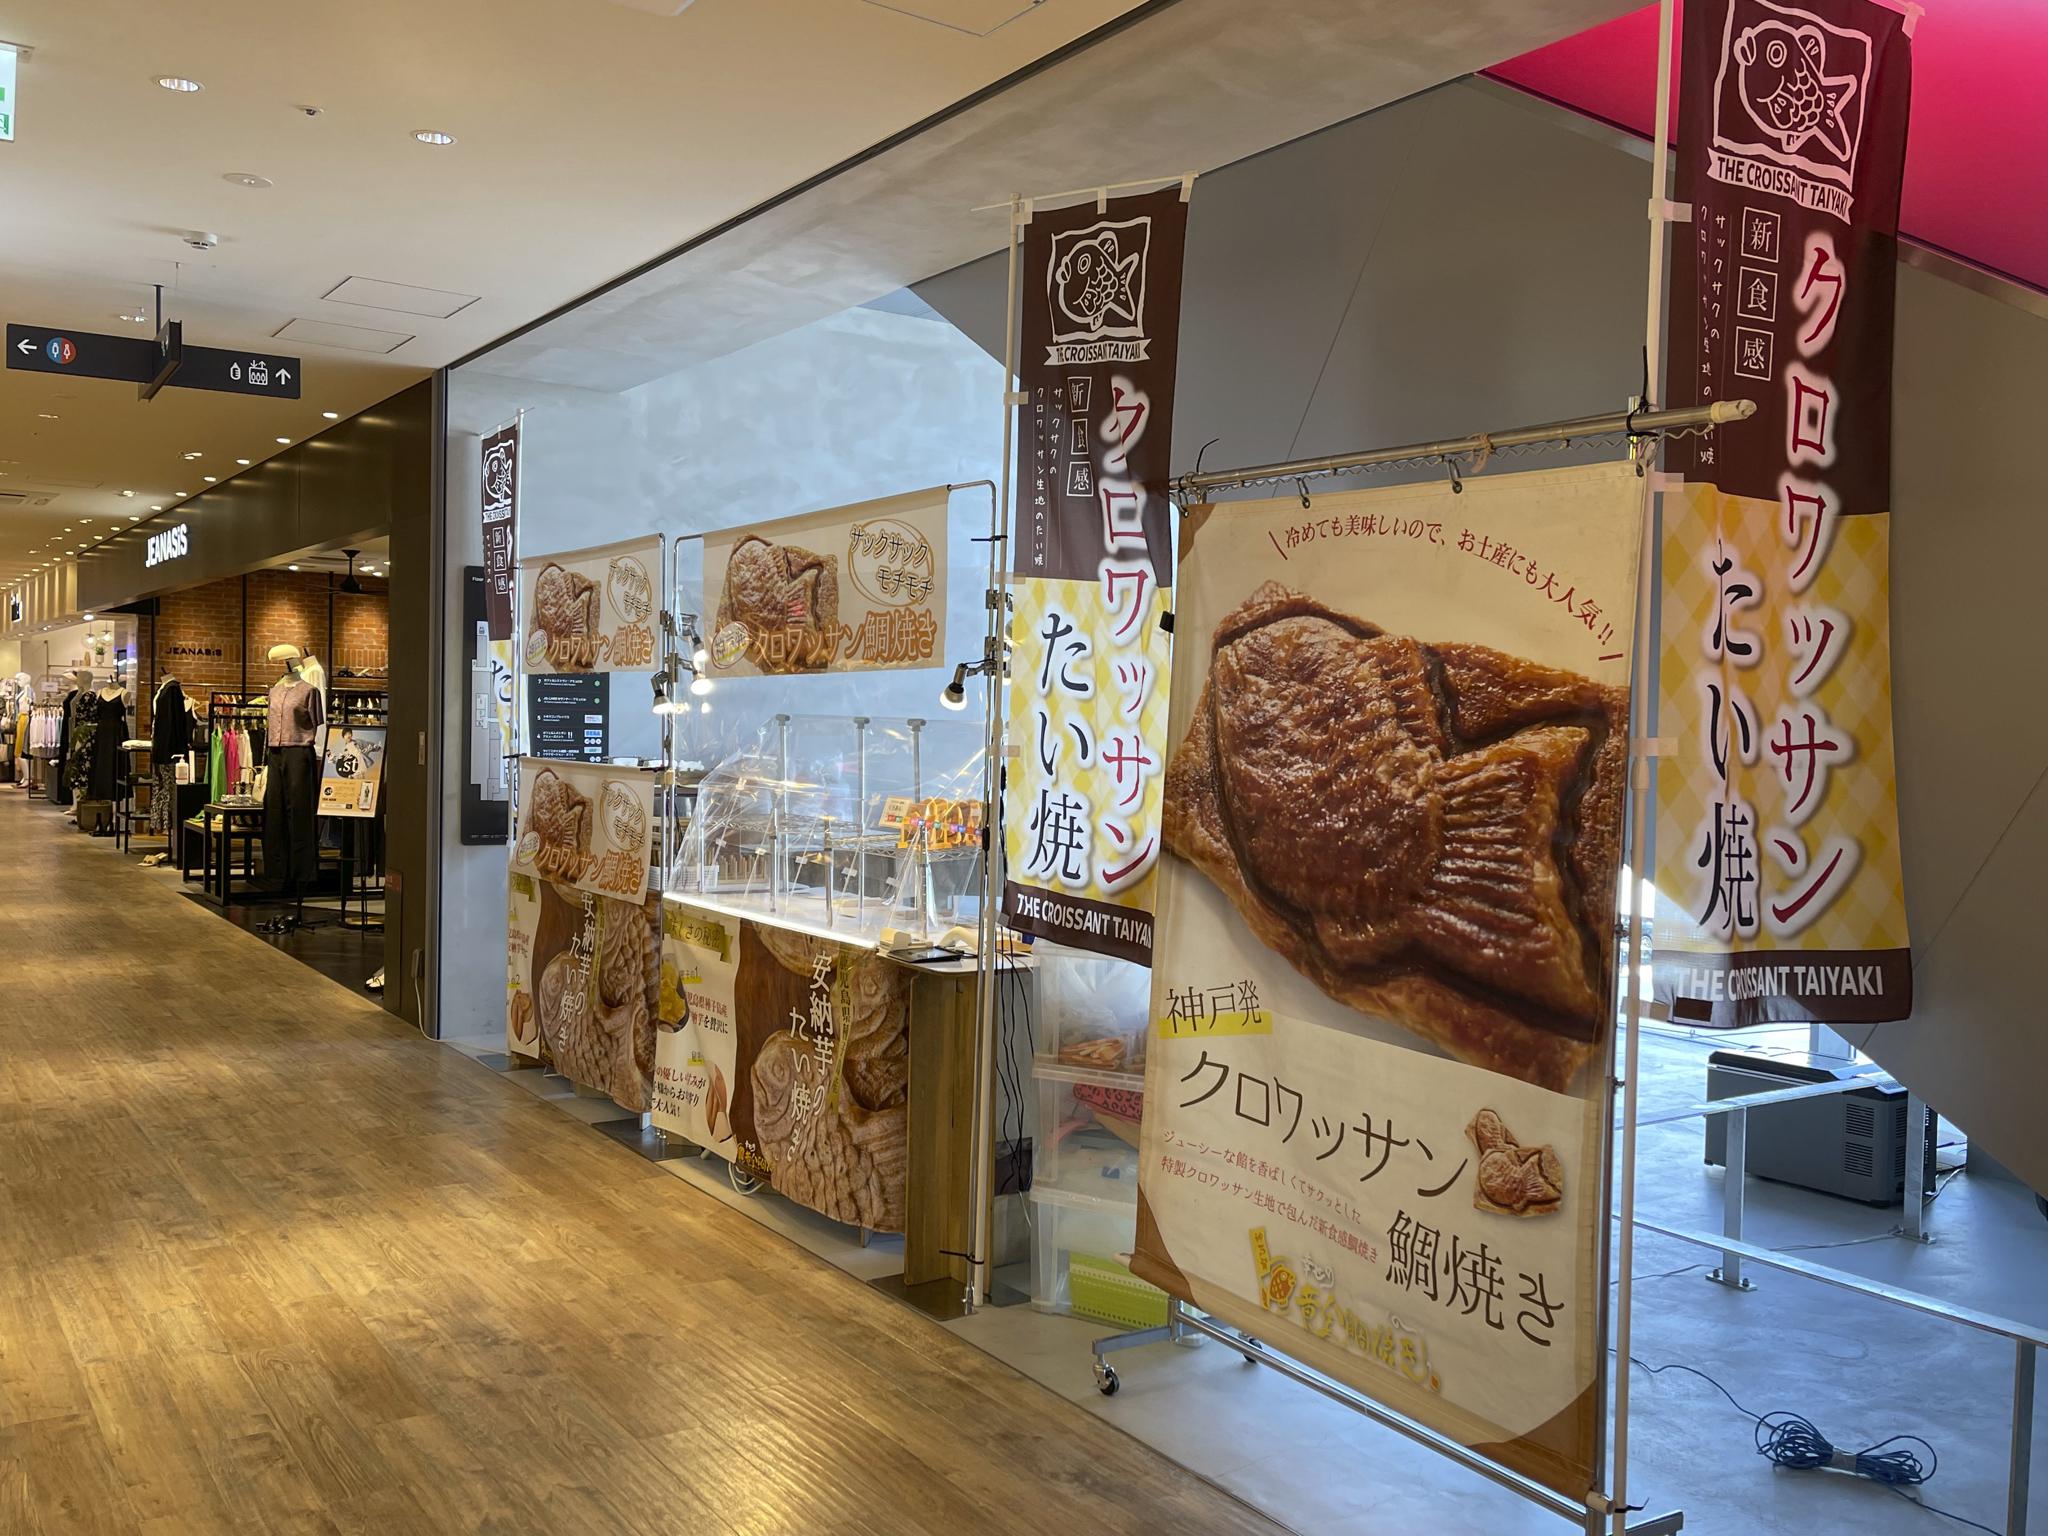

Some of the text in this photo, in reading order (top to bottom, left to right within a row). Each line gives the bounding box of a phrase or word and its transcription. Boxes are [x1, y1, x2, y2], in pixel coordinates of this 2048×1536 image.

[1717, 156, 1744, 183] THE
[1711, 214, 1725, 339] サックサクの
[1743, 218, 1773, 370] 新食感
[1049, 387, 1063, 475] サックサクの
[851, 525, 929, 567] サックサック
[877, 566, 934, 602] モチモチ
[1770, 247, 1843, 924] クロワッサン
[754, 609, 937, 664] クロワッサン鯛焼き
[1102, 387, 1153, 884] クロワッサン
[1028, 612, 1089, 880] たい焼
[1698, 539, 1755, 930] たい焼
[1016, 893, 1041, 919] THE
[1042, 900, 1111, 935] CROISSANT
[810, 950, 834, 1117] 安納芋の
[1166, 980, 1262, 1034] 神戸発
[1677, 967, 1724, 1001] THE
[1794, 966, 1884, 996] TAIYAKI
[787, 1005, 812, 1162] たい焼き
[1180, 1051, 1468, 1197] クロワッサン
[1385, 1209, 1565, 1347] 鯛焼き
